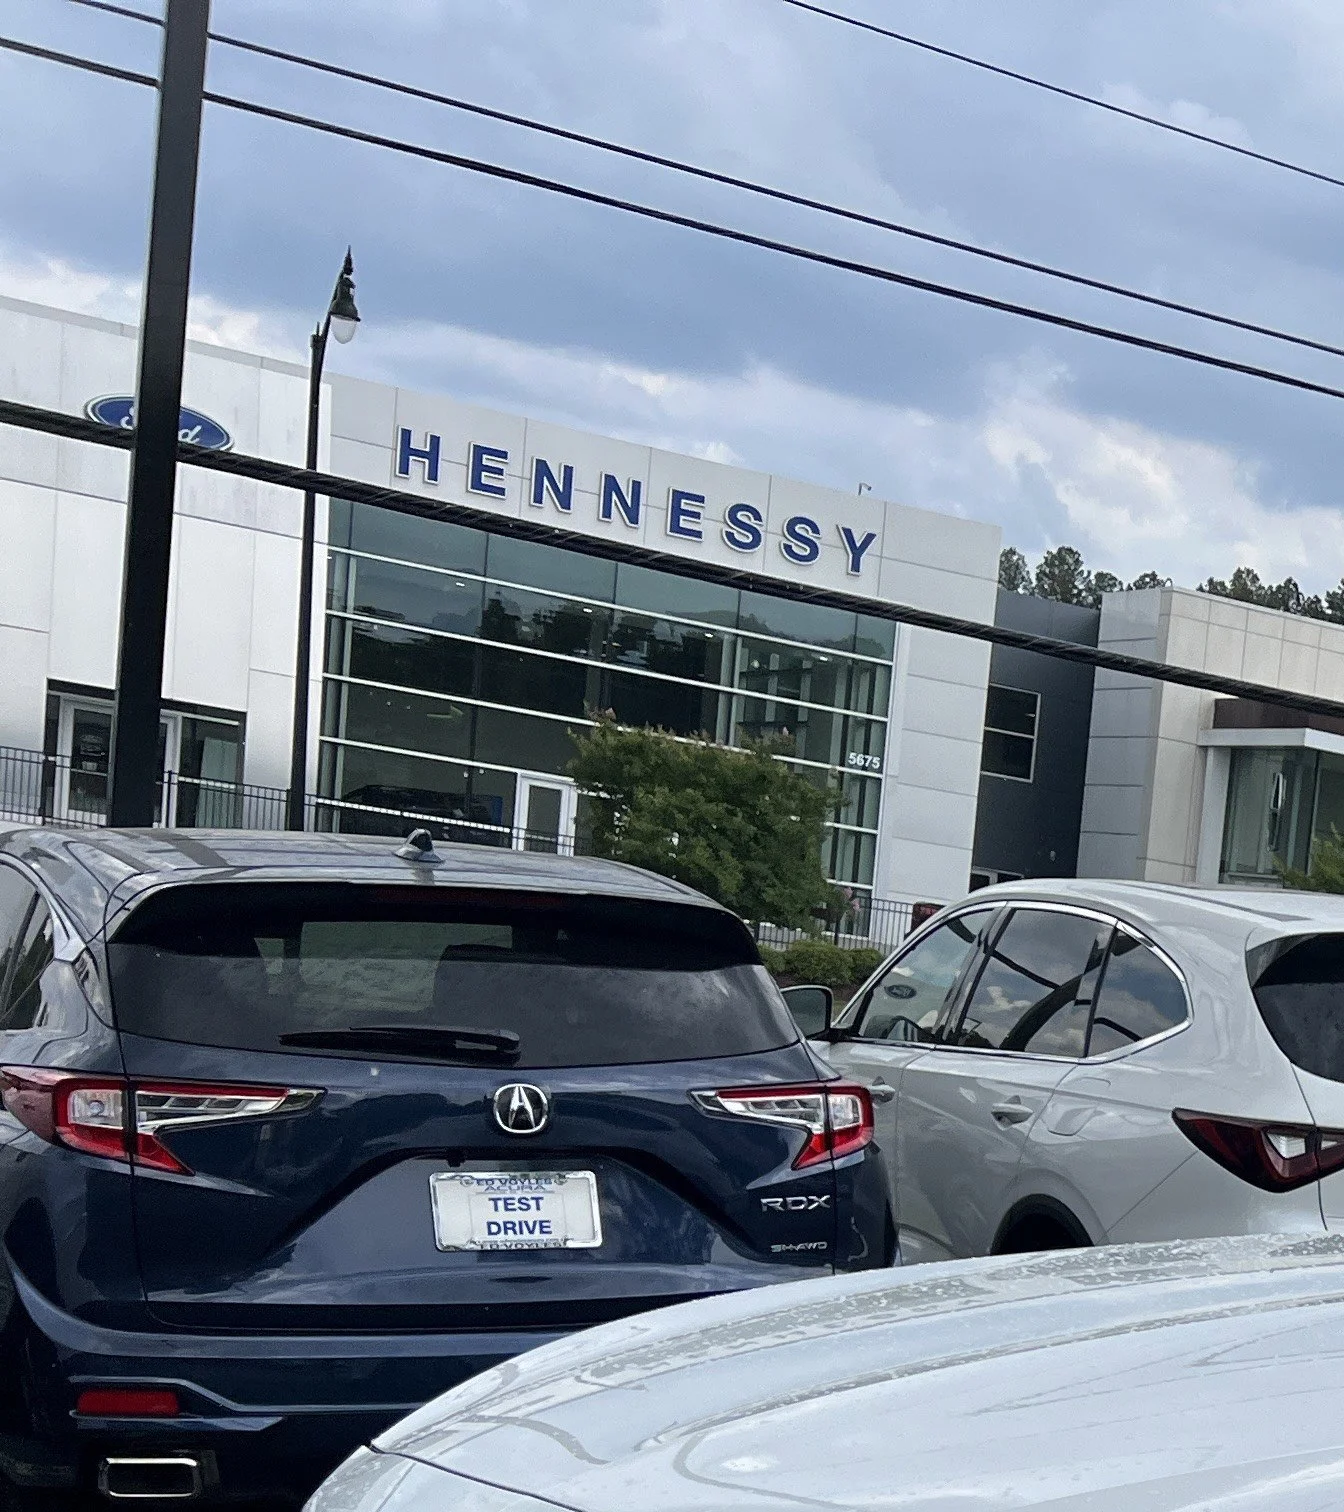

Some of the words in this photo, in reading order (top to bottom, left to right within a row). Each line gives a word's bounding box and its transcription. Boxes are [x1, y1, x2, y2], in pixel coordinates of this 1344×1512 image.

[394, 424, 877, 576] HENNESSY
[848, 752, 881, 769] 5675
[488, 1196, 544, 1212] TEST
[760, 1194, 831, 1212] RDX
[486, 1220, 553, 1236] DRIVE
